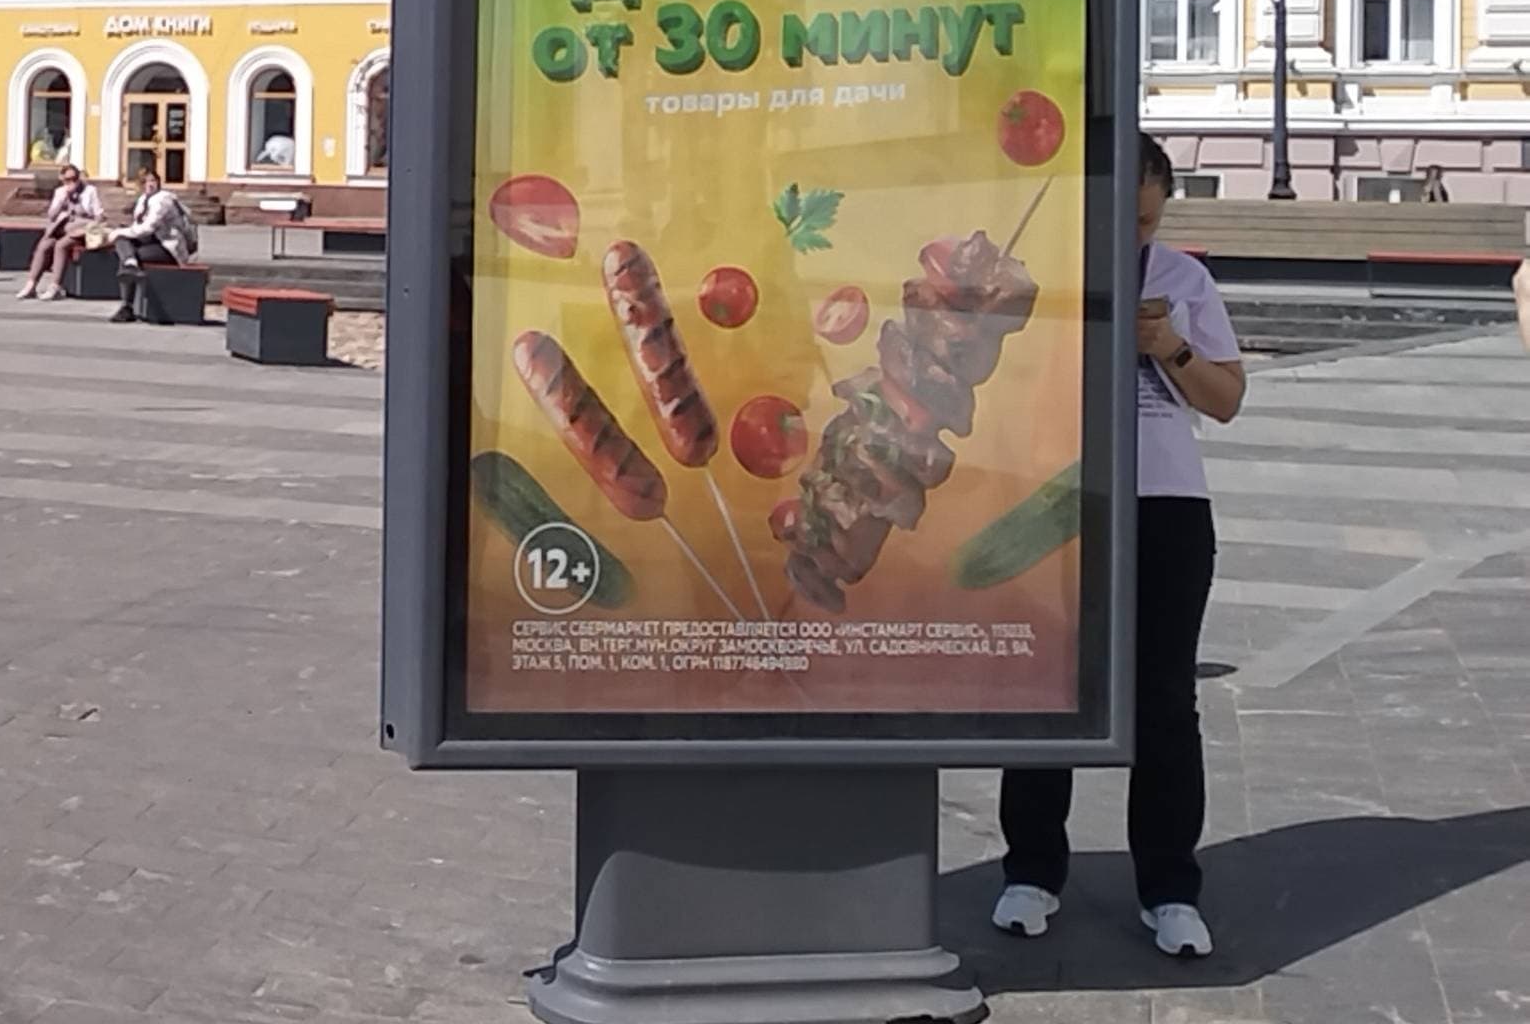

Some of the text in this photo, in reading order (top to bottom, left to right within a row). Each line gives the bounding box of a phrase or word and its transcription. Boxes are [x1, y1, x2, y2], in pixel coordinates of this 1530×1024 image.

[533, 0, 1026, 83] от 30 минут
[645, 83, 906, 118] товары для дачи
[527, 548, 591, 589] 12+
[512, 620, 568, 637] СЕРВИС
[569, 620, 660, 637] СБЕРМАРКЕТ
[663, 621, 797, 638] ПРЕДОСТАВЛЯЕТСЯ
[799, 622, 833, 638] ООО
[512, 637, 577, 654] МОСКВА,
[512, 654, 551, 671] ЭТАЖ
[673, 655, 710, 671] ОГРН
